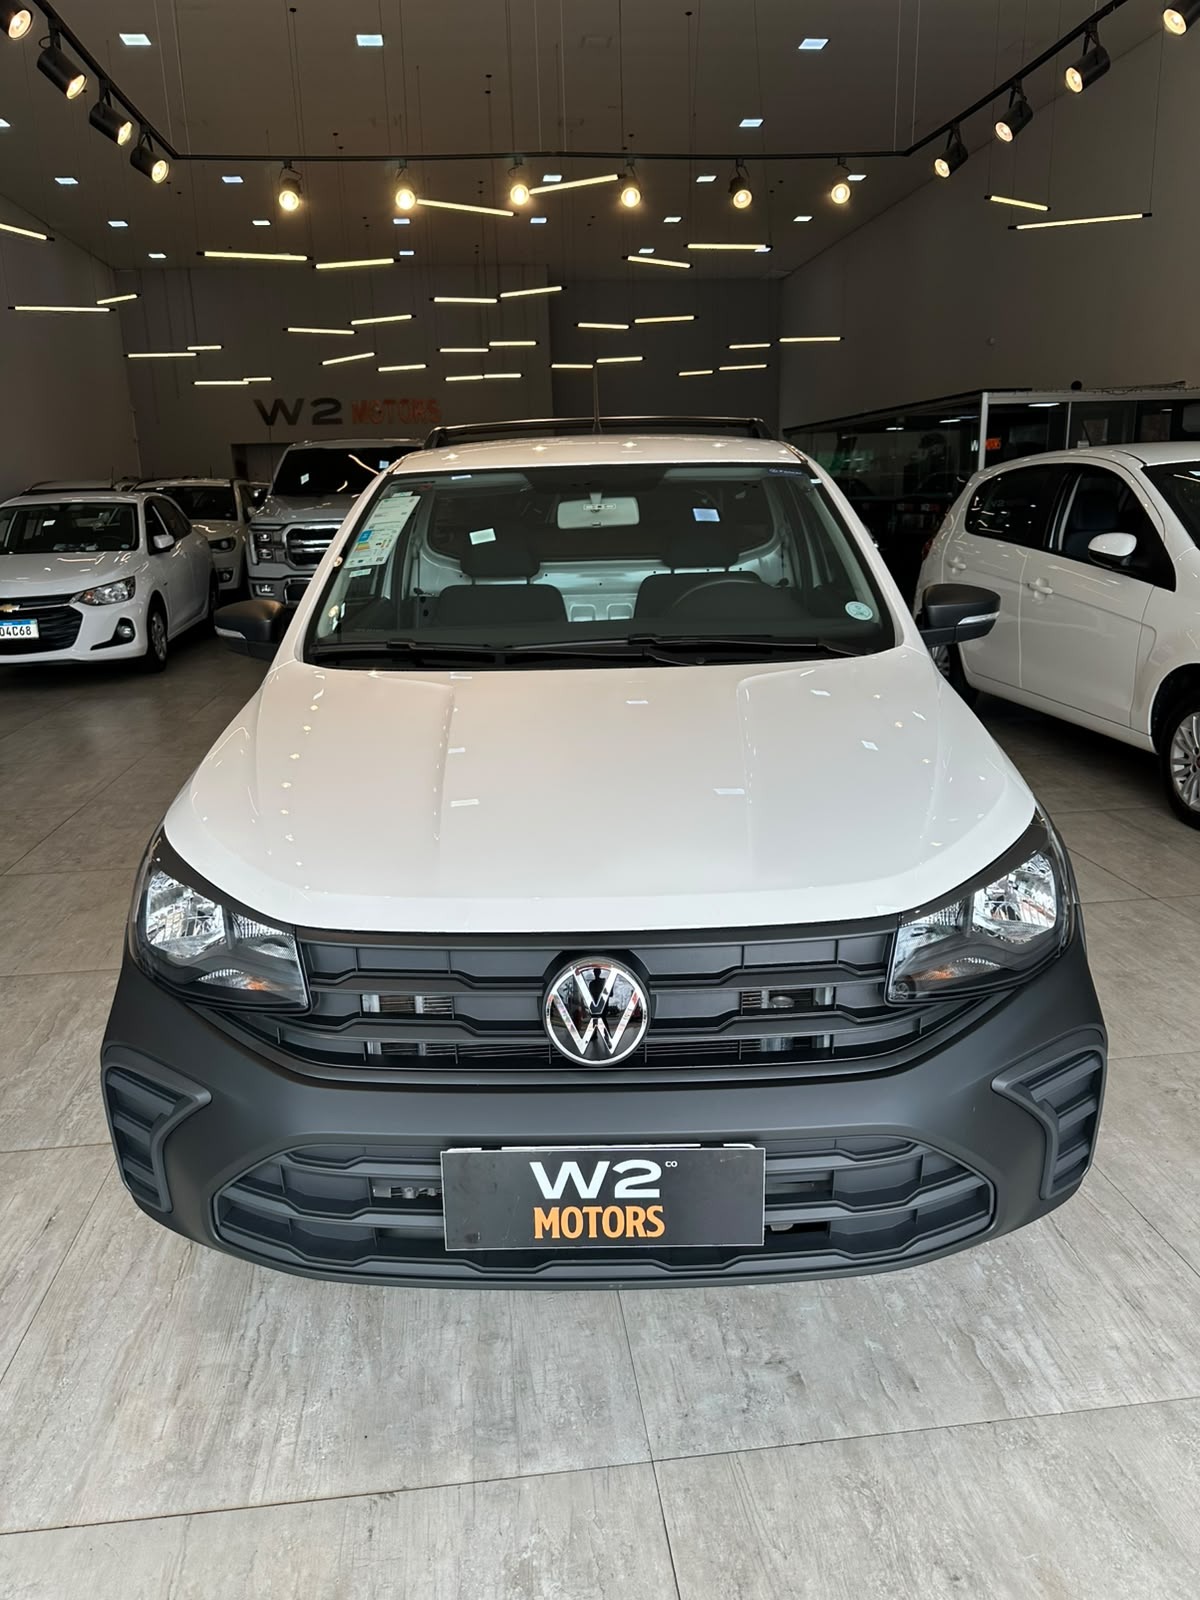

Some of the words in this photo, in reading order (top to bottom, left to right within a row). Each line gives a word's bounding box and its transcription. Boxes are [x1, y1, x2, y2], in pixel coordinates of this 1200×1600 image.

[253, 397, 343, 425] W2
[351, 398, 442, 425] MOTORS
[529, 1159, 662, 1199] W2
[533, 1204, 666, 1240] MOTORS
